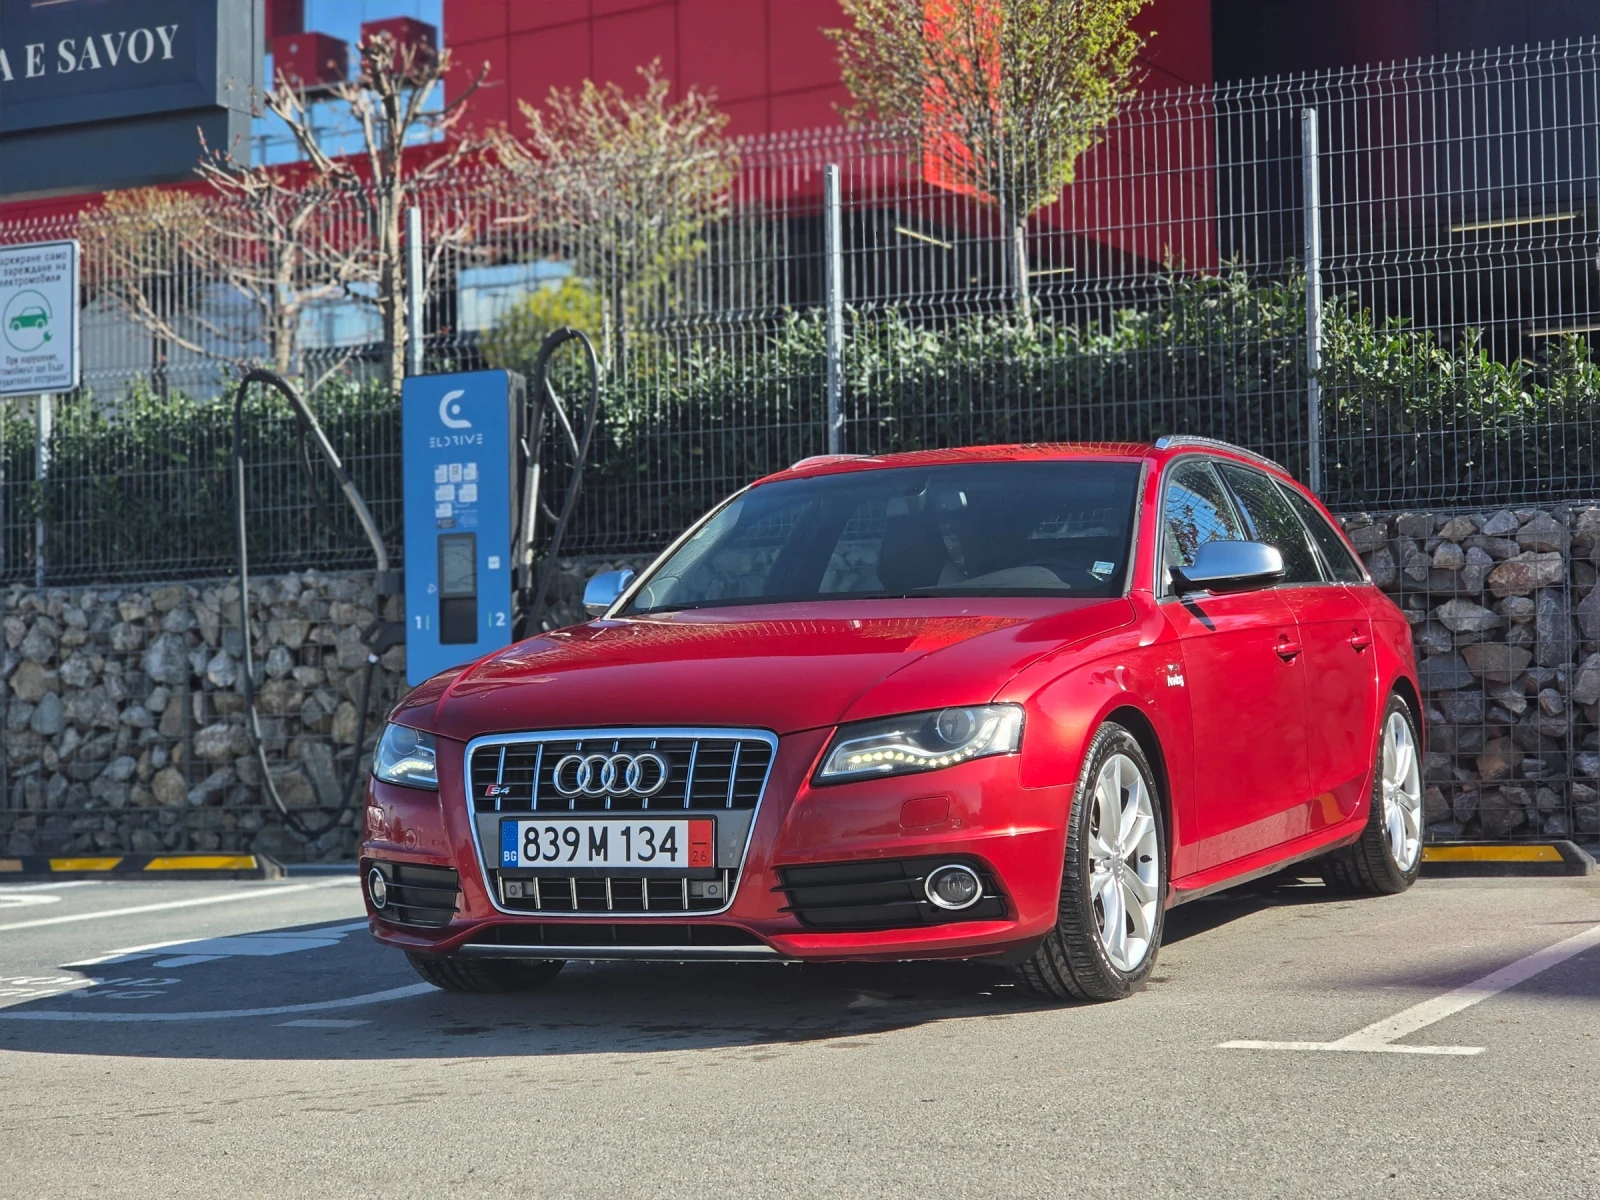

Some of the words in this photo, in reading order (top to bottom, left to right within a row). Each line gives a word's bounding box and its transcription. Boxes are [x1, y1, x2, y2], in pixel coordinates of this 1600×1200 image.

[24, 43, 46, 78] E
[57, 24, 179, 74] SAVOY
[44, 251, 67, 262] само
[429, 433, 484, 448] ELDRIVE
[415, 615, 422, 630] 1
[495, 612, 506, 627] 2
[491, 786, 510, 795] S4
[523, 826, 581, 862] 839
[588, 826, 609, 862] M
[620, 826, 678, 862] 134
[503, 851, 518, 862] BG
[692, 850, 708, 862] 26
